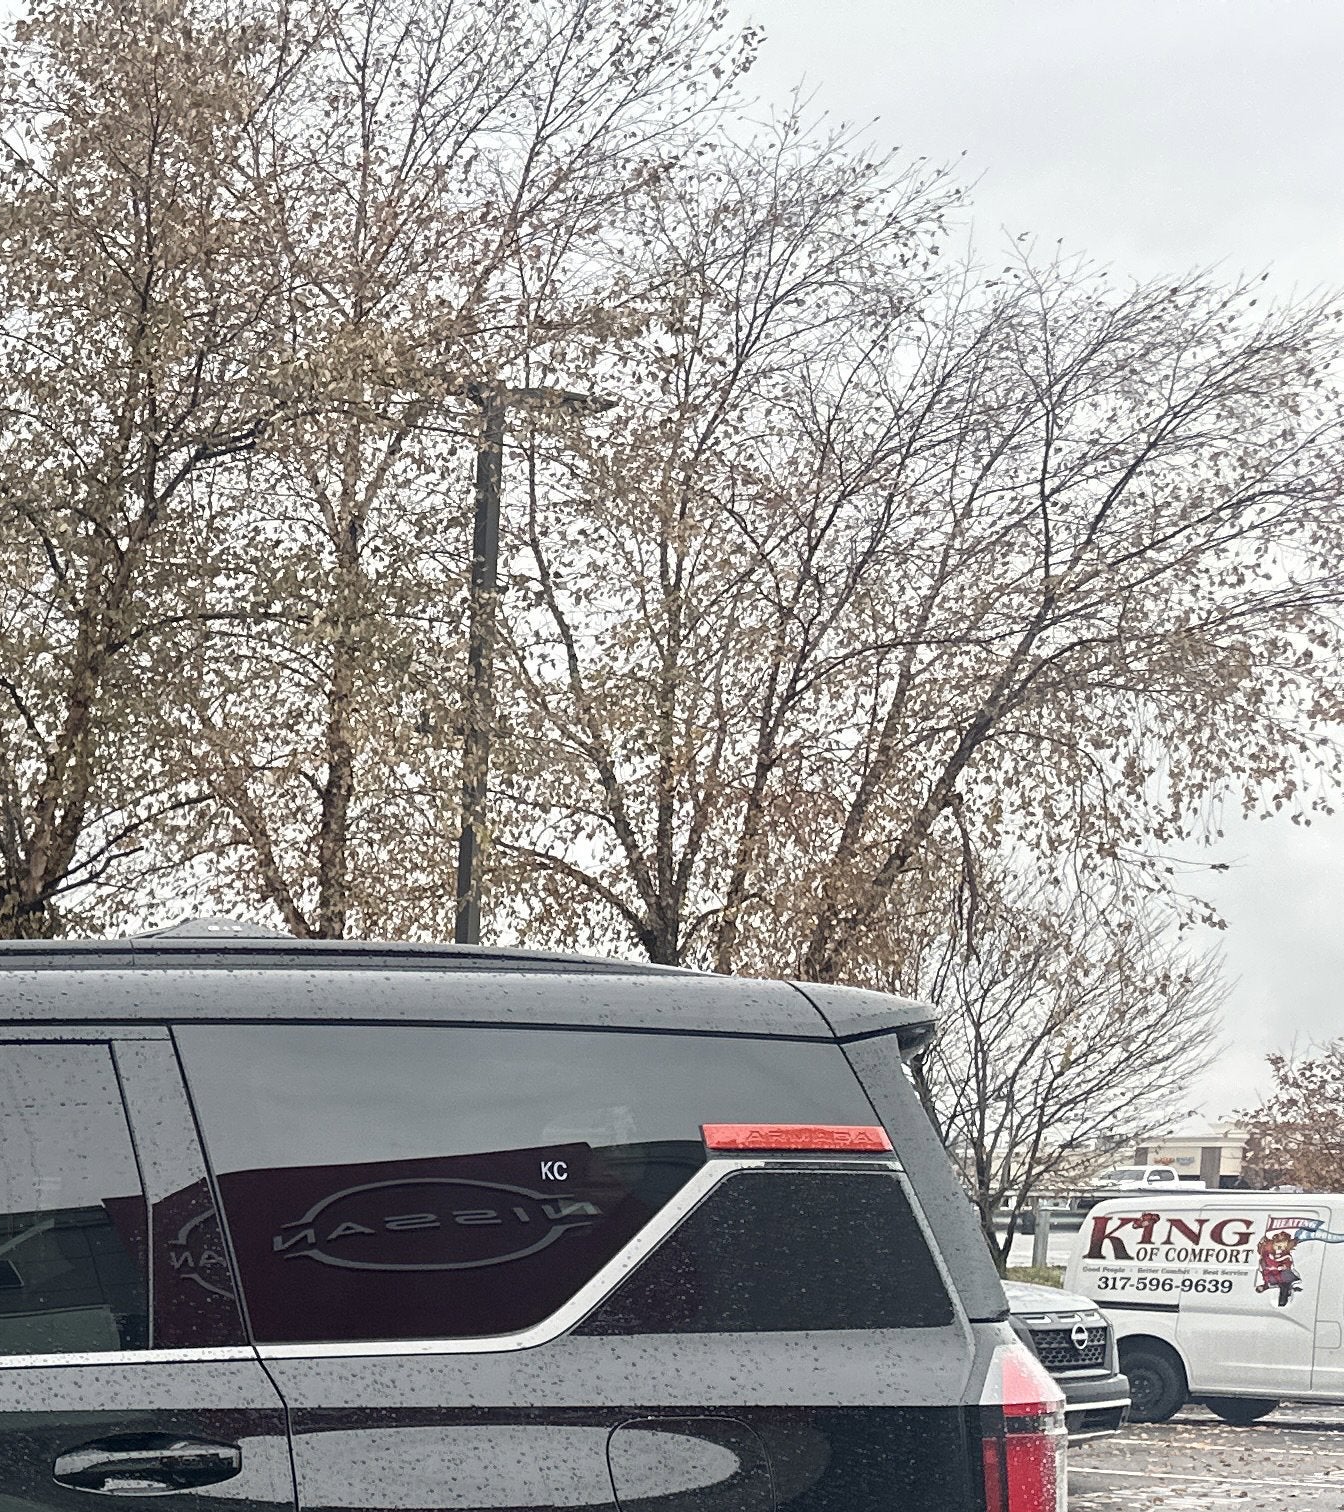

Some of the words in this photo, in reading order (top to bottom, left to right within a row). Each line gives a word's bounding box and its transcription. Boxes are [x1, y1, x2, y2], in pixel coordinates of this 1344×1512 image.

[541, 1161, 568, 1180] KC
[1135, 1247, 1160, 1262] OF
[1165, 1247, 1254, 1264] COMFORT
[1097, 1275, 1233, 1293] 317-596-9639
